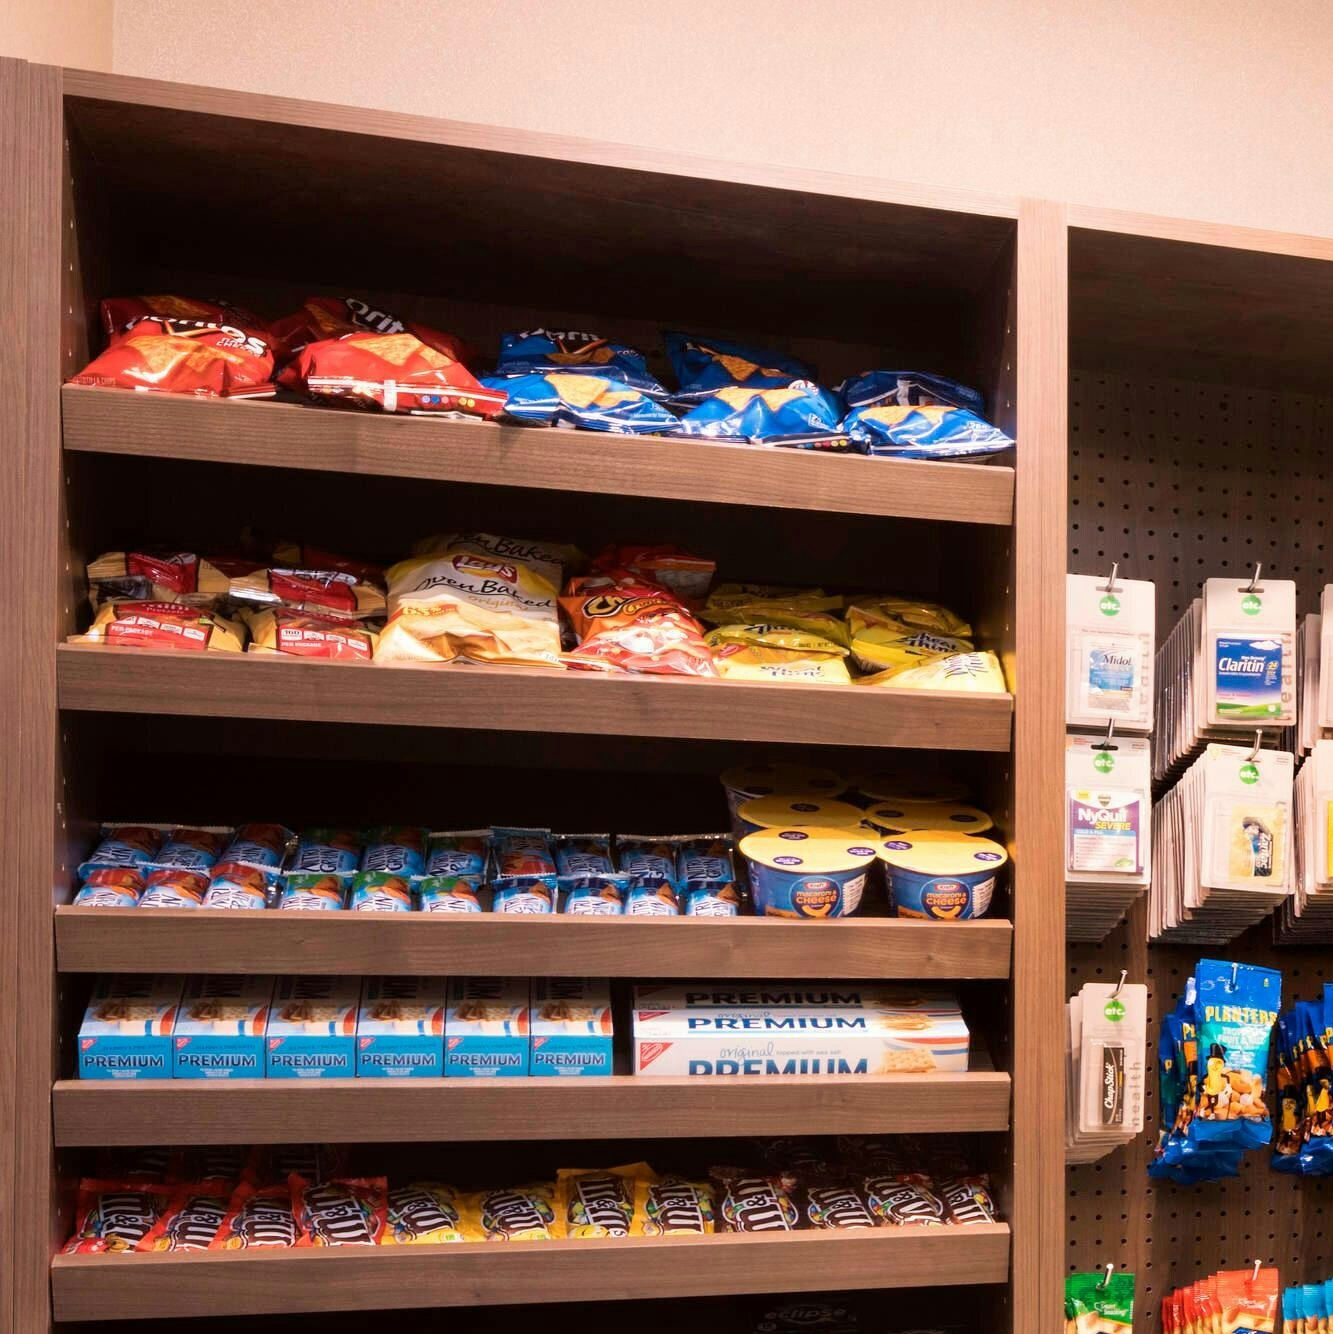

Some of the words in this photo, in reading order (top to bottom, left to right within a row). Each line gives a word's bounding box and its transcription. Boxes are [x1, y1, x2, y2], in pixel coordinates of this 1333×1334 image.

[1102, 654, 1132, 666] Midol
[1219, 658, 1264, 672] Claritin
[1078, 808, 1128, 824] NyQuil
[1095, 822, 1131, 831] SEVERE
[685, 991, 861, 1005] PREMIUM
[688, 1017, 866, 1030] PREMIUM
[84, 1055, 164, 1067] PREMIUM
[178, 1054, 256, 1066] PREMIUM
[272, 1055, 346, 1066] PREMIUM
[362, 1054, 435, 1066] PREMIUM
[450, 1054, 520, 1065] PREMIUM
[535, 1054, 604, 1065] PREMIUM
[1104, 1062, 1115, 1110] ChapStick
